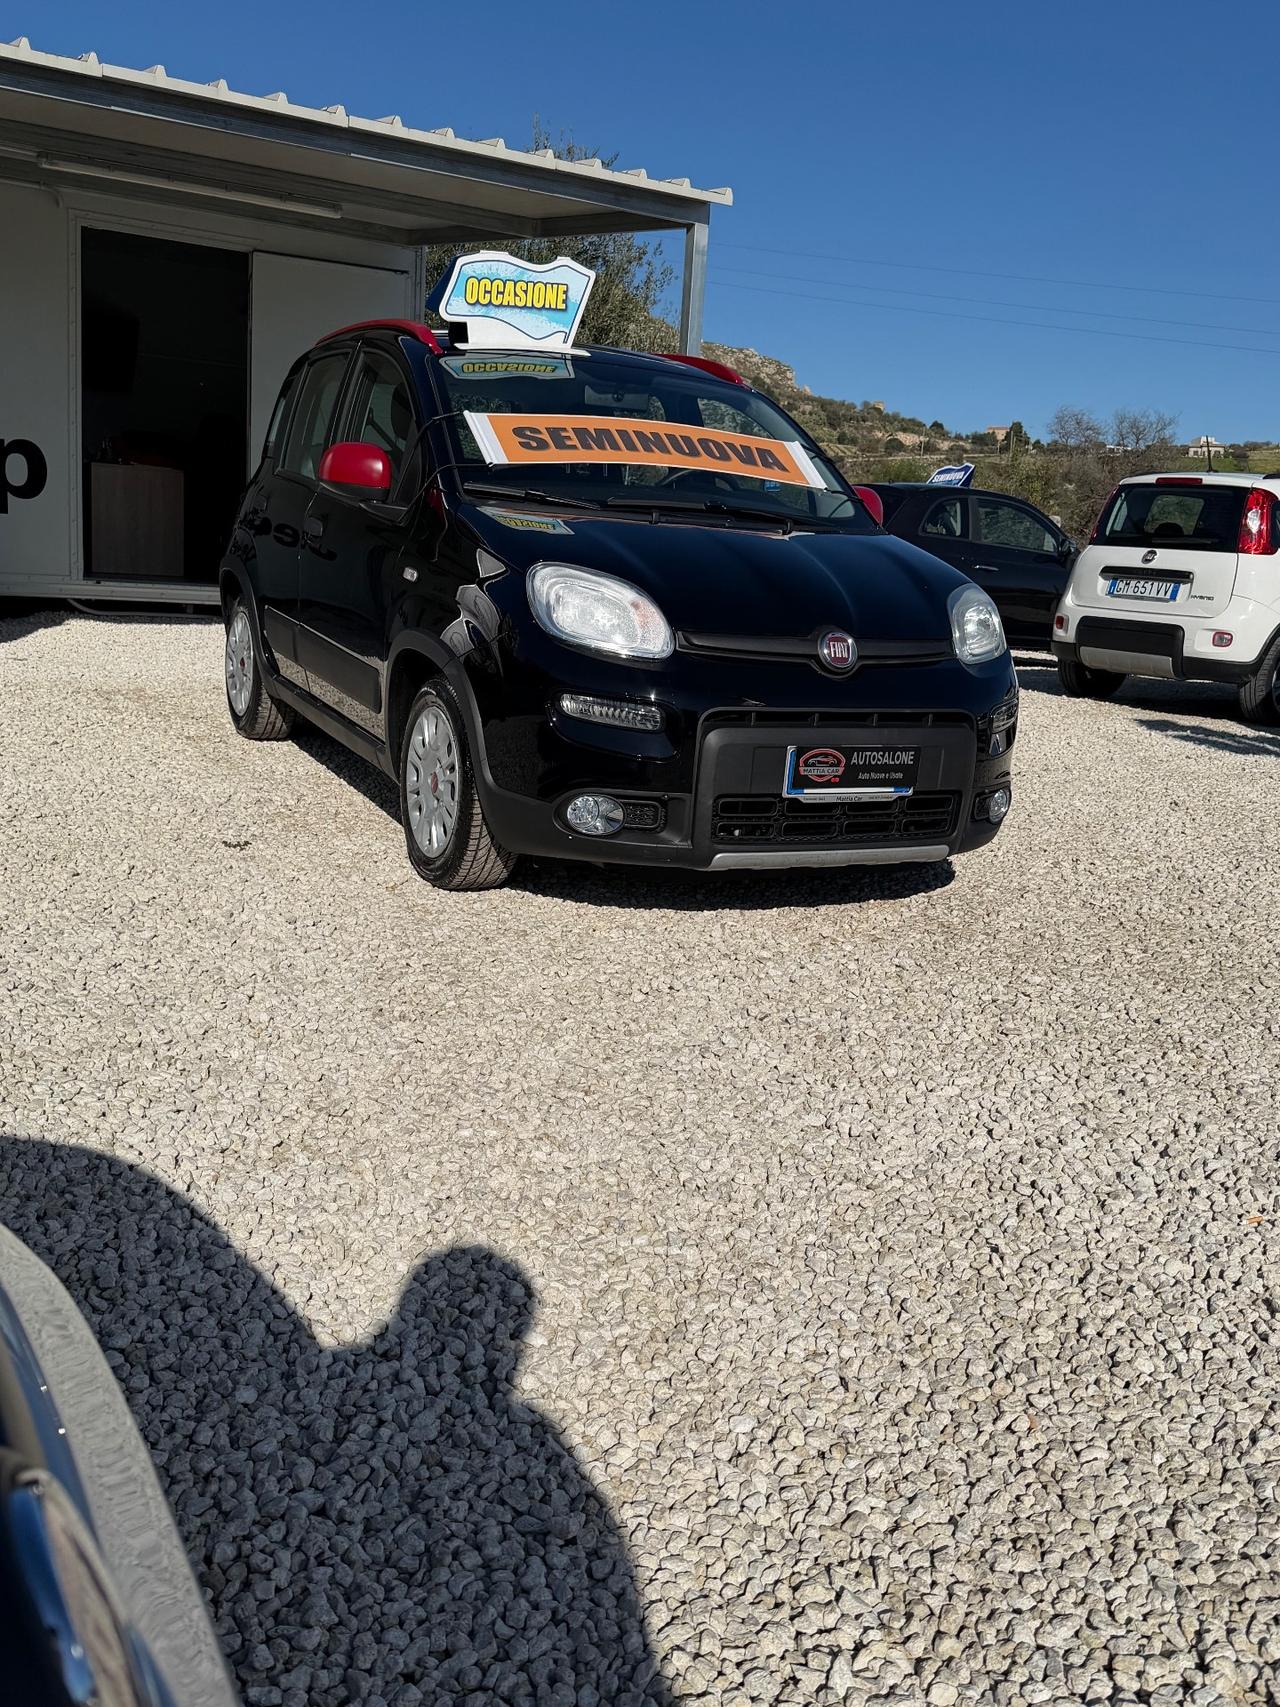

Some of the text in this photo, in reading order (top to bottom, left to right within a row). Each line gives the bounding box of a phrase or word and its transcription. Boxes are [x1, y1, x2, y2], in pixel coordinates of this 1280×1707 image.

[466, 277, 568, 311] OCCASIONE
[511, 425, 790, 473] SEMINUOVA
[830, 641, 848, 658] FIAT
[850, 751, 915, 765] AUTOSALONE
[803, 767, 825, 775] MATTIA
